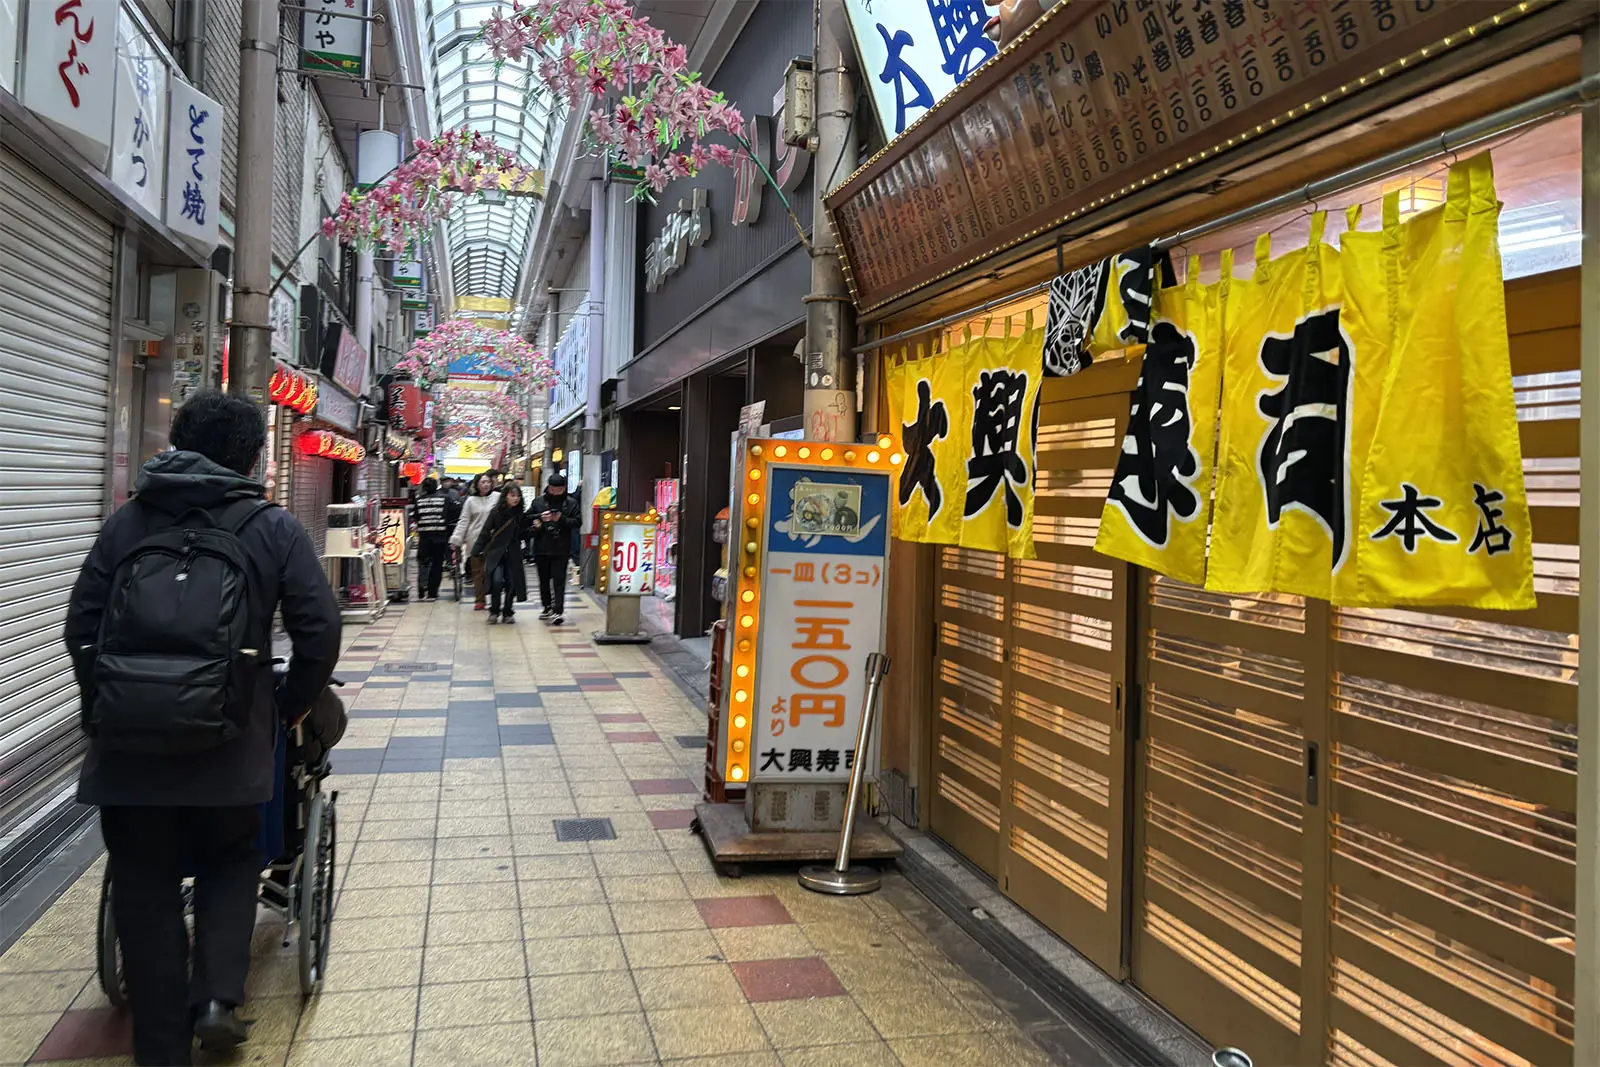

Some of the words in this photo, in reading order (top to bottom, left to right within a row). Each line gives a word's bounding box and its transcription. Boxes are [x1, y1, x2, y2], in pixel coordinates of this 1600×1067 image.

[315, 0, 336, 48] がや
[181, 104, 210, 226] どて焼
[1371, 482, 1514, 557] 本店
[613, 541, 638, 573] 50
[770, 696, 787, 737] より
